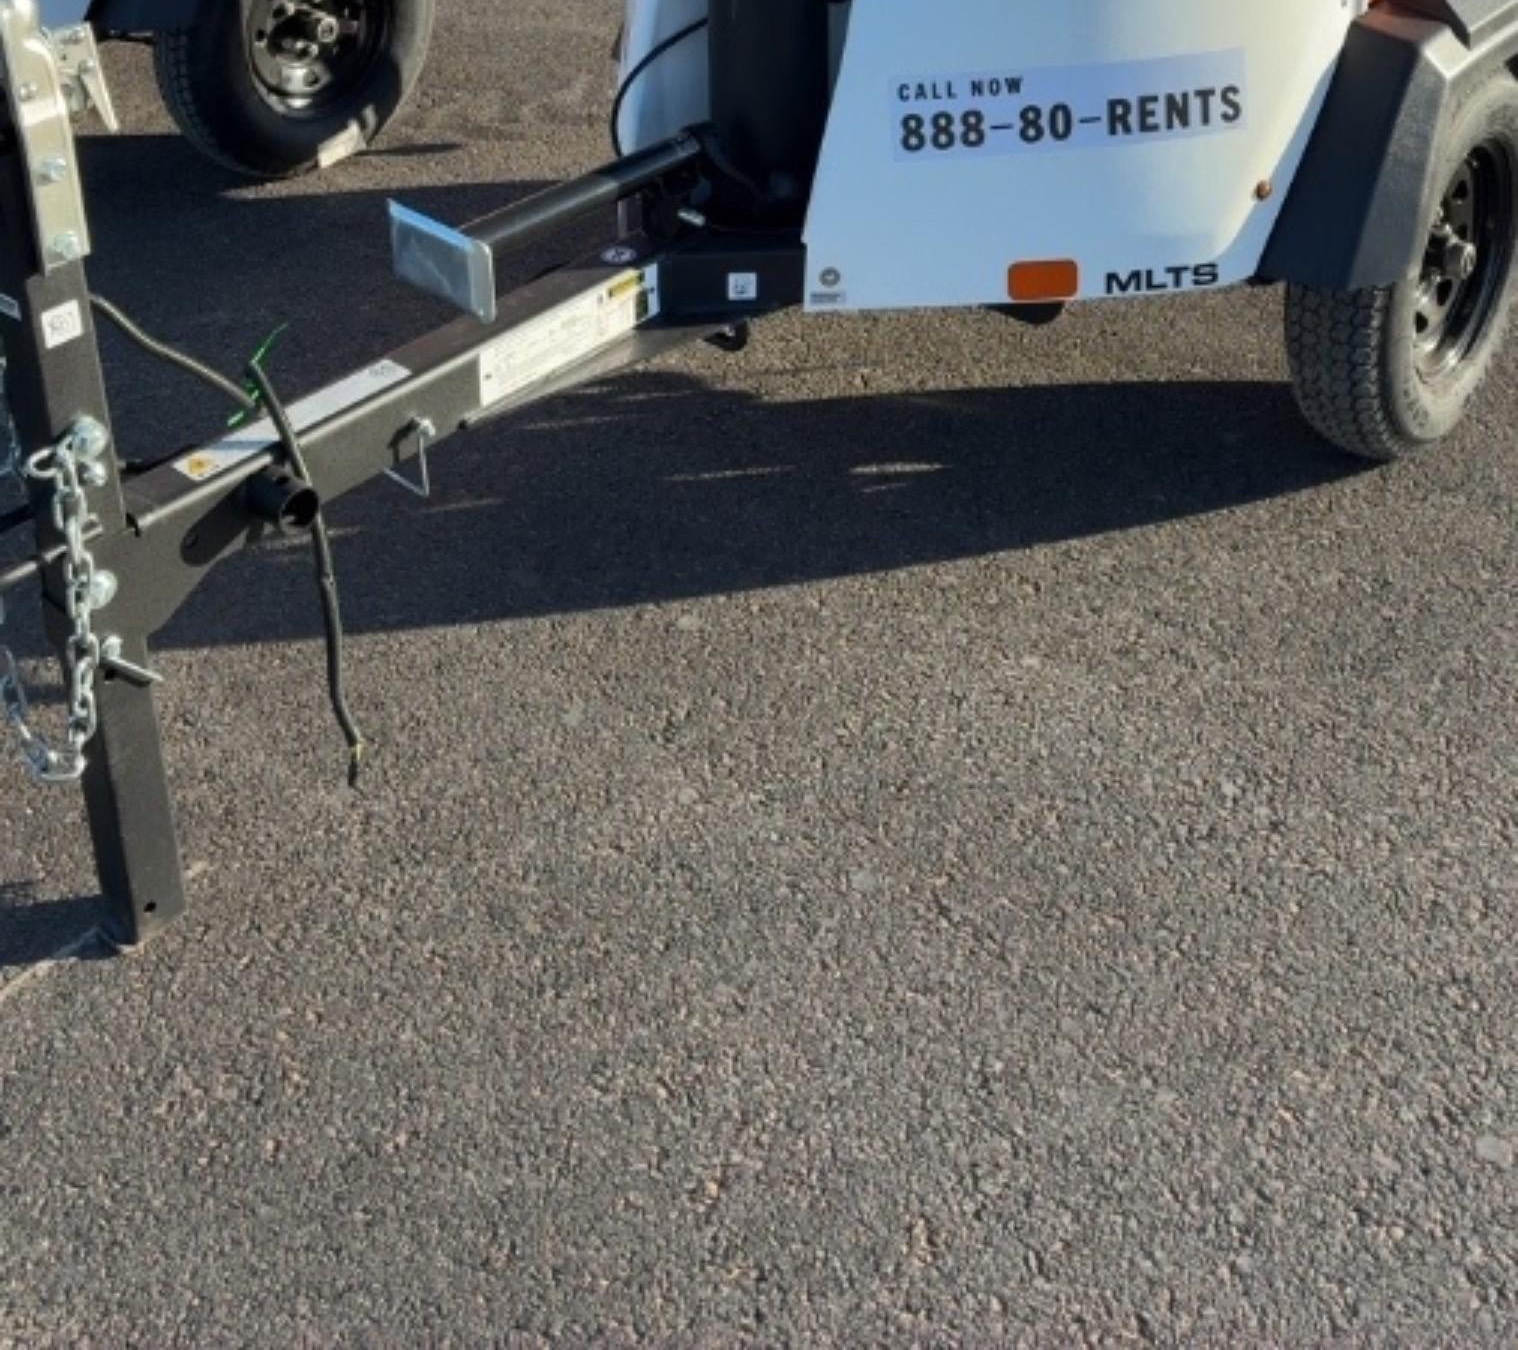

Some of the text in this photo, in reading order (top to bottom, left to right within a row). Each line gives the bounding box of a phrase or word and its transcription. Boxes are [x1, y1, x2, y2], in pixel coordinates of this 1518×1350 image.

[897, 76, 1024, 101] CALL NOW
[900, 84, 1242, 152] 888-80-RENTS
[1105, 262, 1220, 295] MLTS
